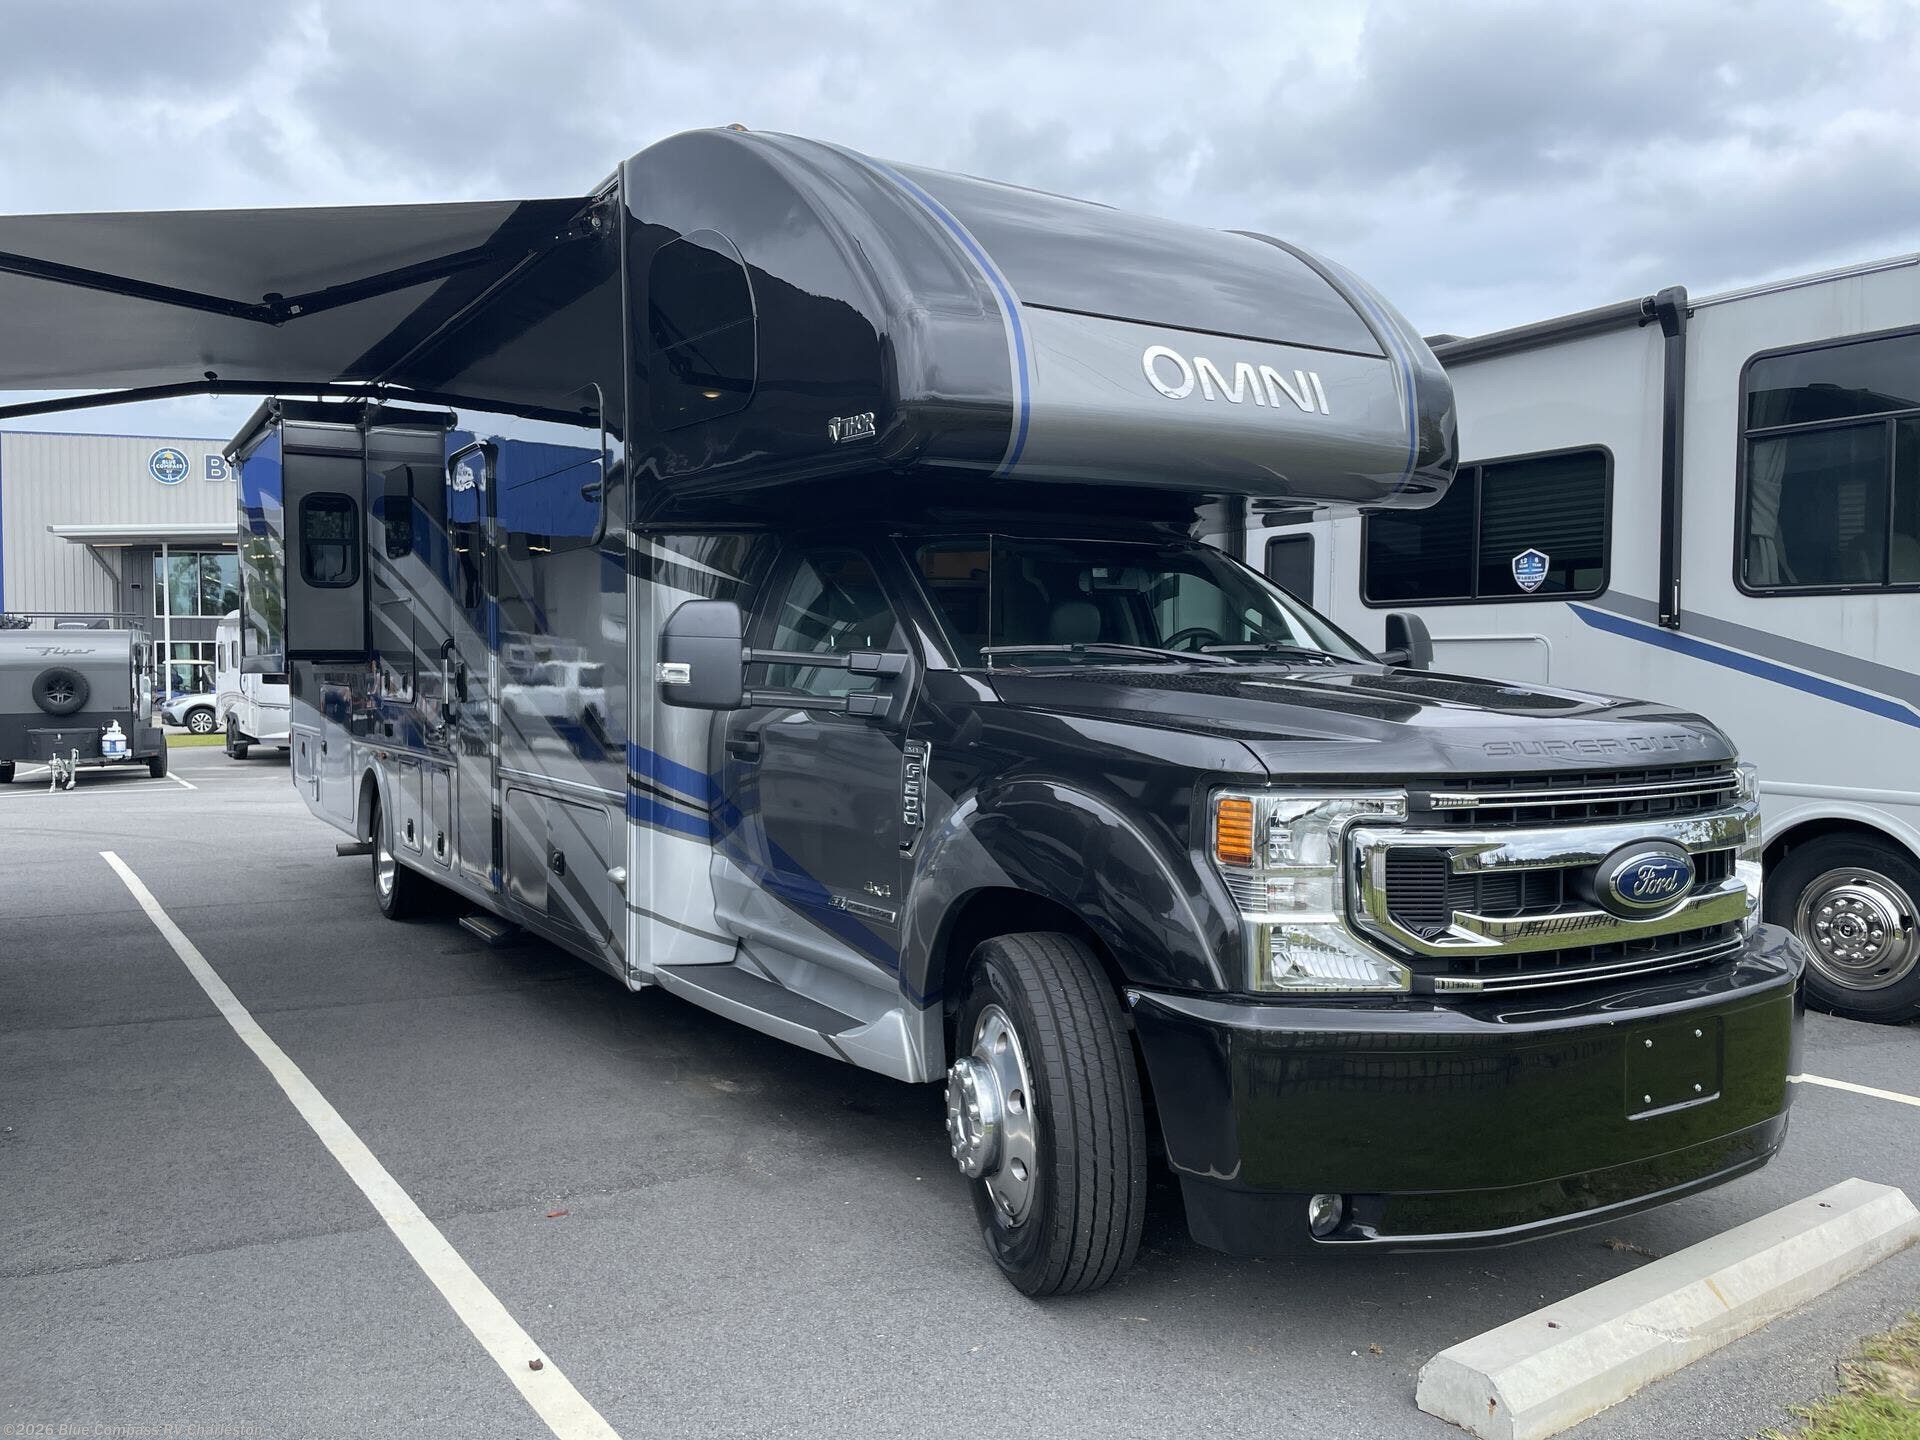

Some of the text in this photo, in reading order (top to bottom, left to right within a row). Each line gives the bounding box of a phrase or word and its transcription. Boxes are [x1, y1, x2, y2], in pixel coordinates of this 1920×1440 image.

[1141, 345, 1330, 416] OMNI
[840, 412, 876, 437] THOR
[1482, 734, 1707, 757] SUPER DUTY
[1633, 864, 1678, 896] Ford
